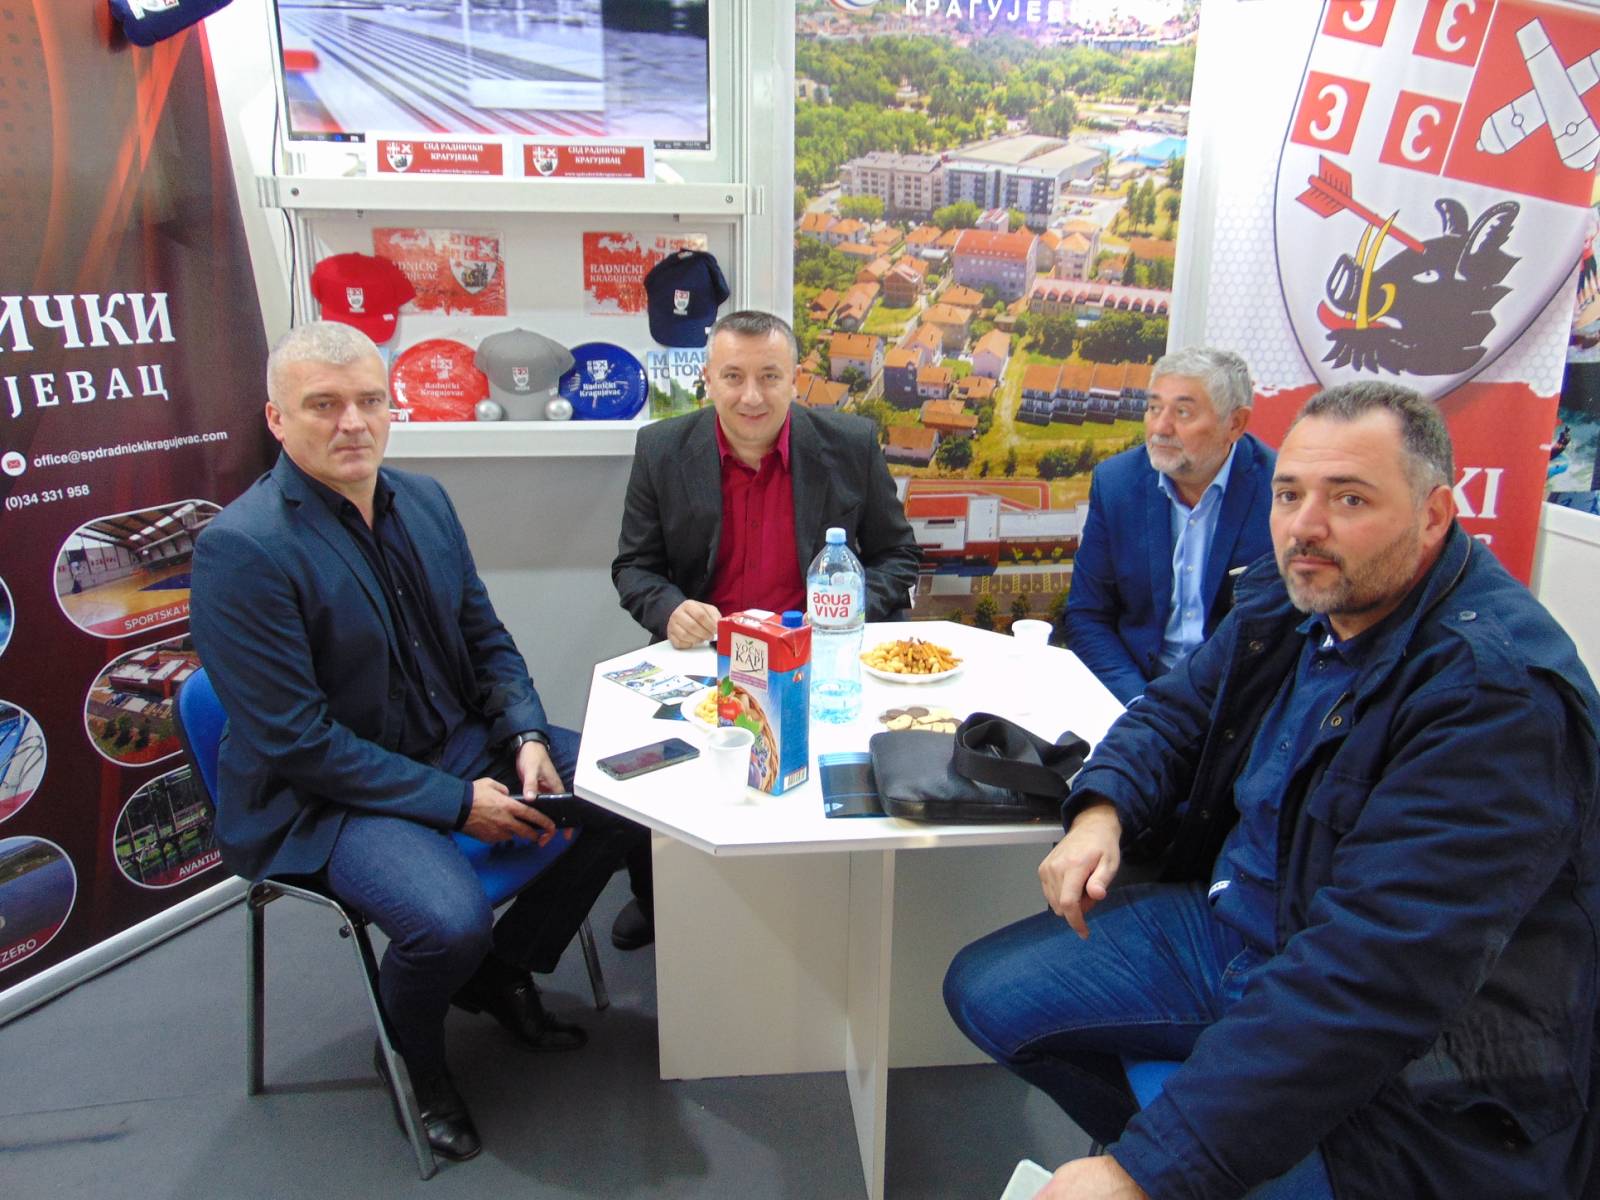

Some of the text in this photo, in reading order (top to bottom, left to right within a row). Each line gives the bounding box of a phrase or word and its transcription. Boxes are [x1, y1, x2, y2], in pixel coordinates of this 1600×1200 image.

[904, 0, 1064, 23] КРАГУЈЕ
[590, 263, 643, 274] RADNIČKI
[41, 489, 63, 503] 331
[66, 484, 90, 498] 958
[125, 606, 181, 630] SPORTSKA
[815, 605, 849, 618] viva
[735, 651, 764, 671] KAPI
